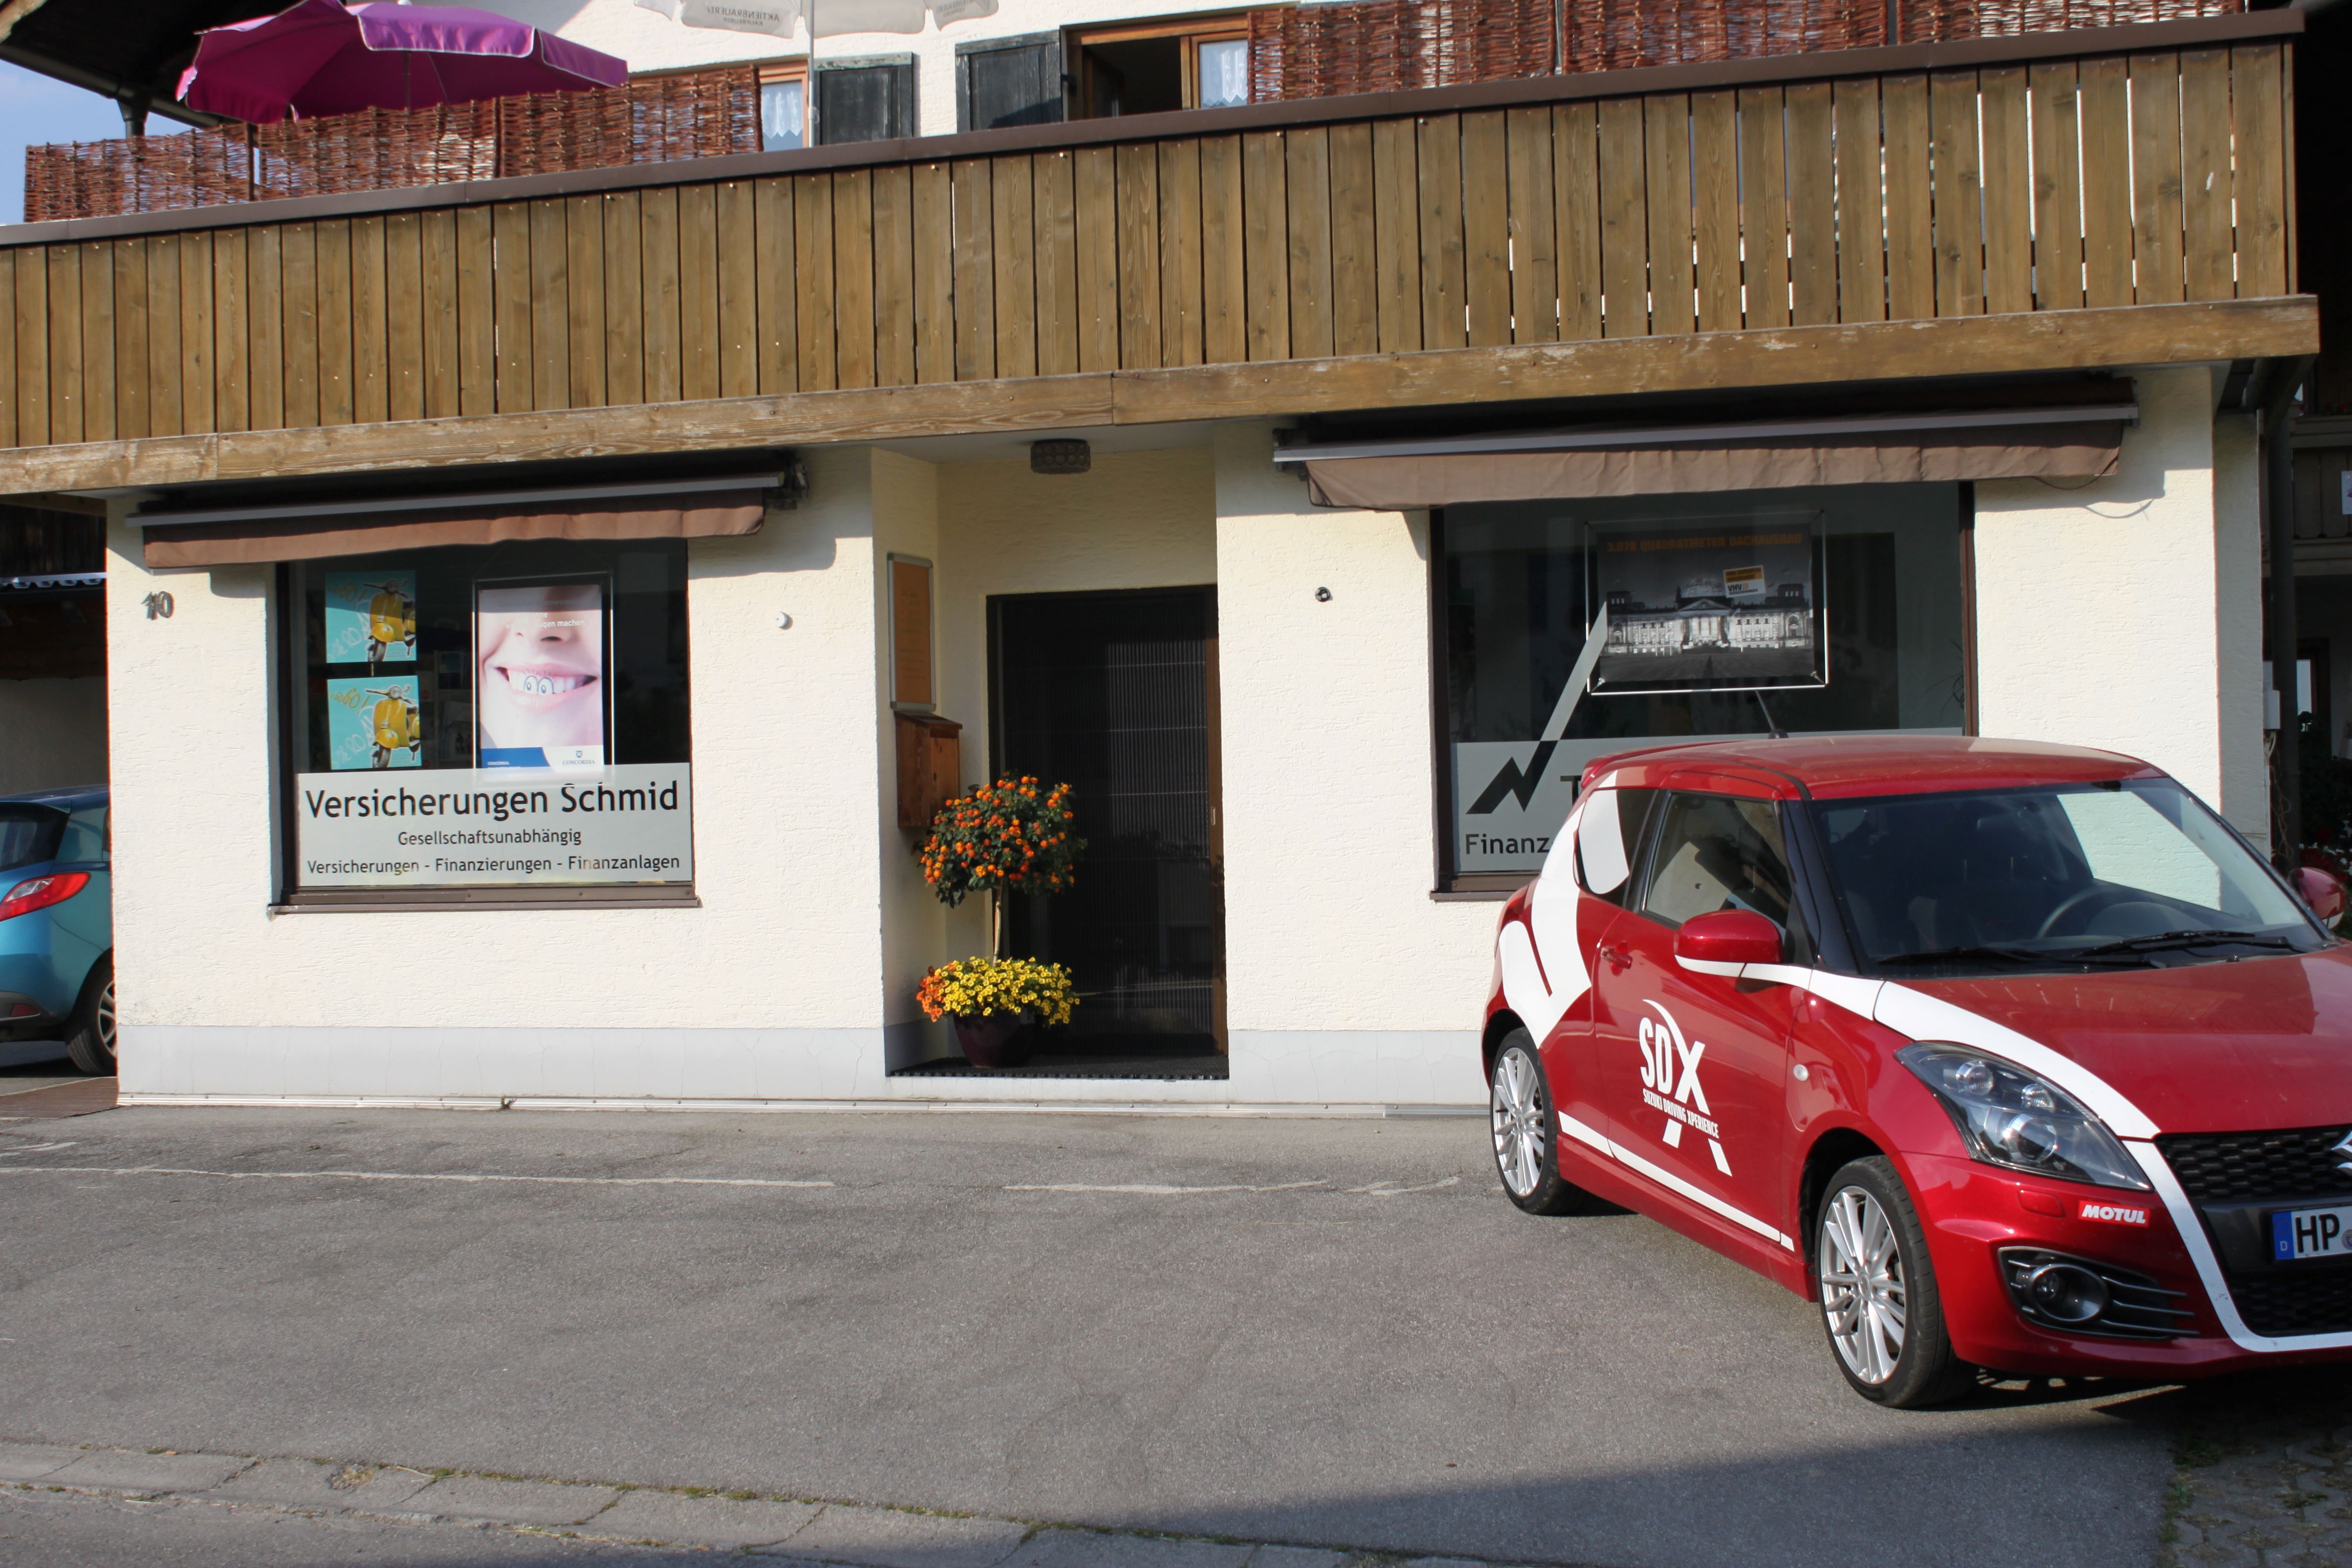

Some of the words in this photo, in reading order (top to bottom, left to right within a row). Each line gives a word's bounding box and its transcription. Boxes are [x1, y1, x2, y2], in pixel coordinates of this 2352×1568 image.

[142, 590, 175, 621] 10
[305, 787, 548, 822] Versicherungen
[561, 780, 678, 813] Schmid
[398, 829, 582, 846] Gesellschaftsunabhängig
[1466, 833, 1553, 855] Finanz
[307, 859, 420, 876] Versicherungen
[436, 858, 551, 874] Finanzierungen
[568, 855, 680, 872] Finanzanlagen
[1639, 1000, 1711, 1116] SDX
[1642, 1088, 1663, 1111] SUZUKI
[1663, 1098, 1686, 1123] DRIVING
[1686, 1109, 1719, 1139] XPERIENCE
[2081, 1204, 2146, 1224] MOTUL
[2280, 1240, 2288, 1252] D
[2295, 1213, 2340, 1253] HP
